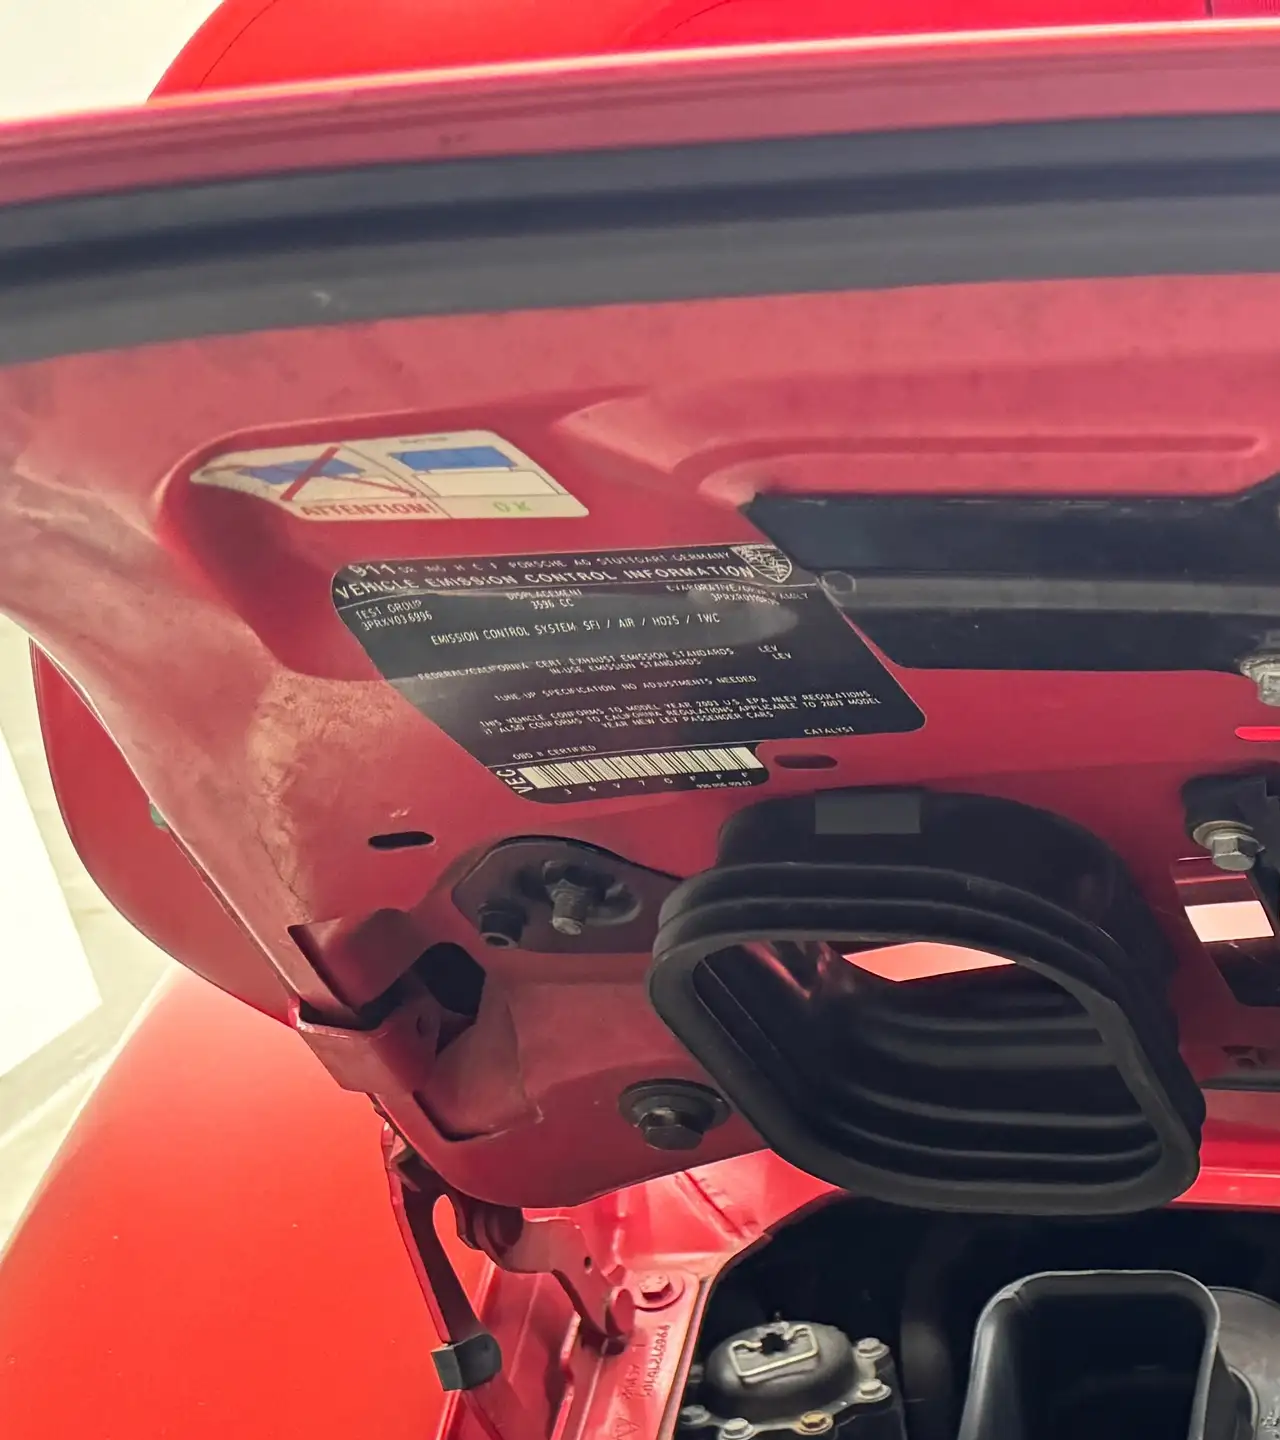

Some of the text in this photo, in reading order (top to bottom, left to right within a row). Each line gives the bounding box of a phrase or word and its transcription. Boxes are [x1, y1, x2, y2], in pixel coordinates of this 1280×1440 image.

[300, 501, 437, 517] ATTENTION!
[348, 563, 396, 578] 911
[335, 565, 756, 600] VEHICLE EMISSION CONTROL INFORMATION
[355, 599, 424, 620] TEST GROUP
[430, 629, 479, 646] EMISSION
[483, 626, 530, 641] CONTROL
[583, 616, 601, 631] SFI
[618, 615, 636, 629] AIR
[697, 612, 721, 624] TWC
[568, 655, 616, 667] EXHAUST
[620, 651, 669, 664] EMISSION
[588, 662, 637, 672] EMISSION
[772, 651, 793, 660] LEV
[642, 677, 713, 690] ADJUSTMENTS
[716, 675, 758, 685] NEEDED
[479, 719, 502, 729] THIS
[505, 713, 545, 725] VEHICLE
[550, 707, 604, 720] CONFORMS
[662, 701, 693, 710] YEAR
[746, 695, 768, 704] EPA
[499, 722, 525, 734] ALSO
[529, 717, 585, 730] CONFORMS
[847, 696, 882, 707] MODEL
[601, 719, 630, 729] YEAR
[632, 716, 655, 726] NEW
[682, 712, 742, 724] PASSENGER
[746, 710, 775, 719] CARS
[803, 726, 856, 736] CATALYST
[496, 768, 535, 796] VEC
